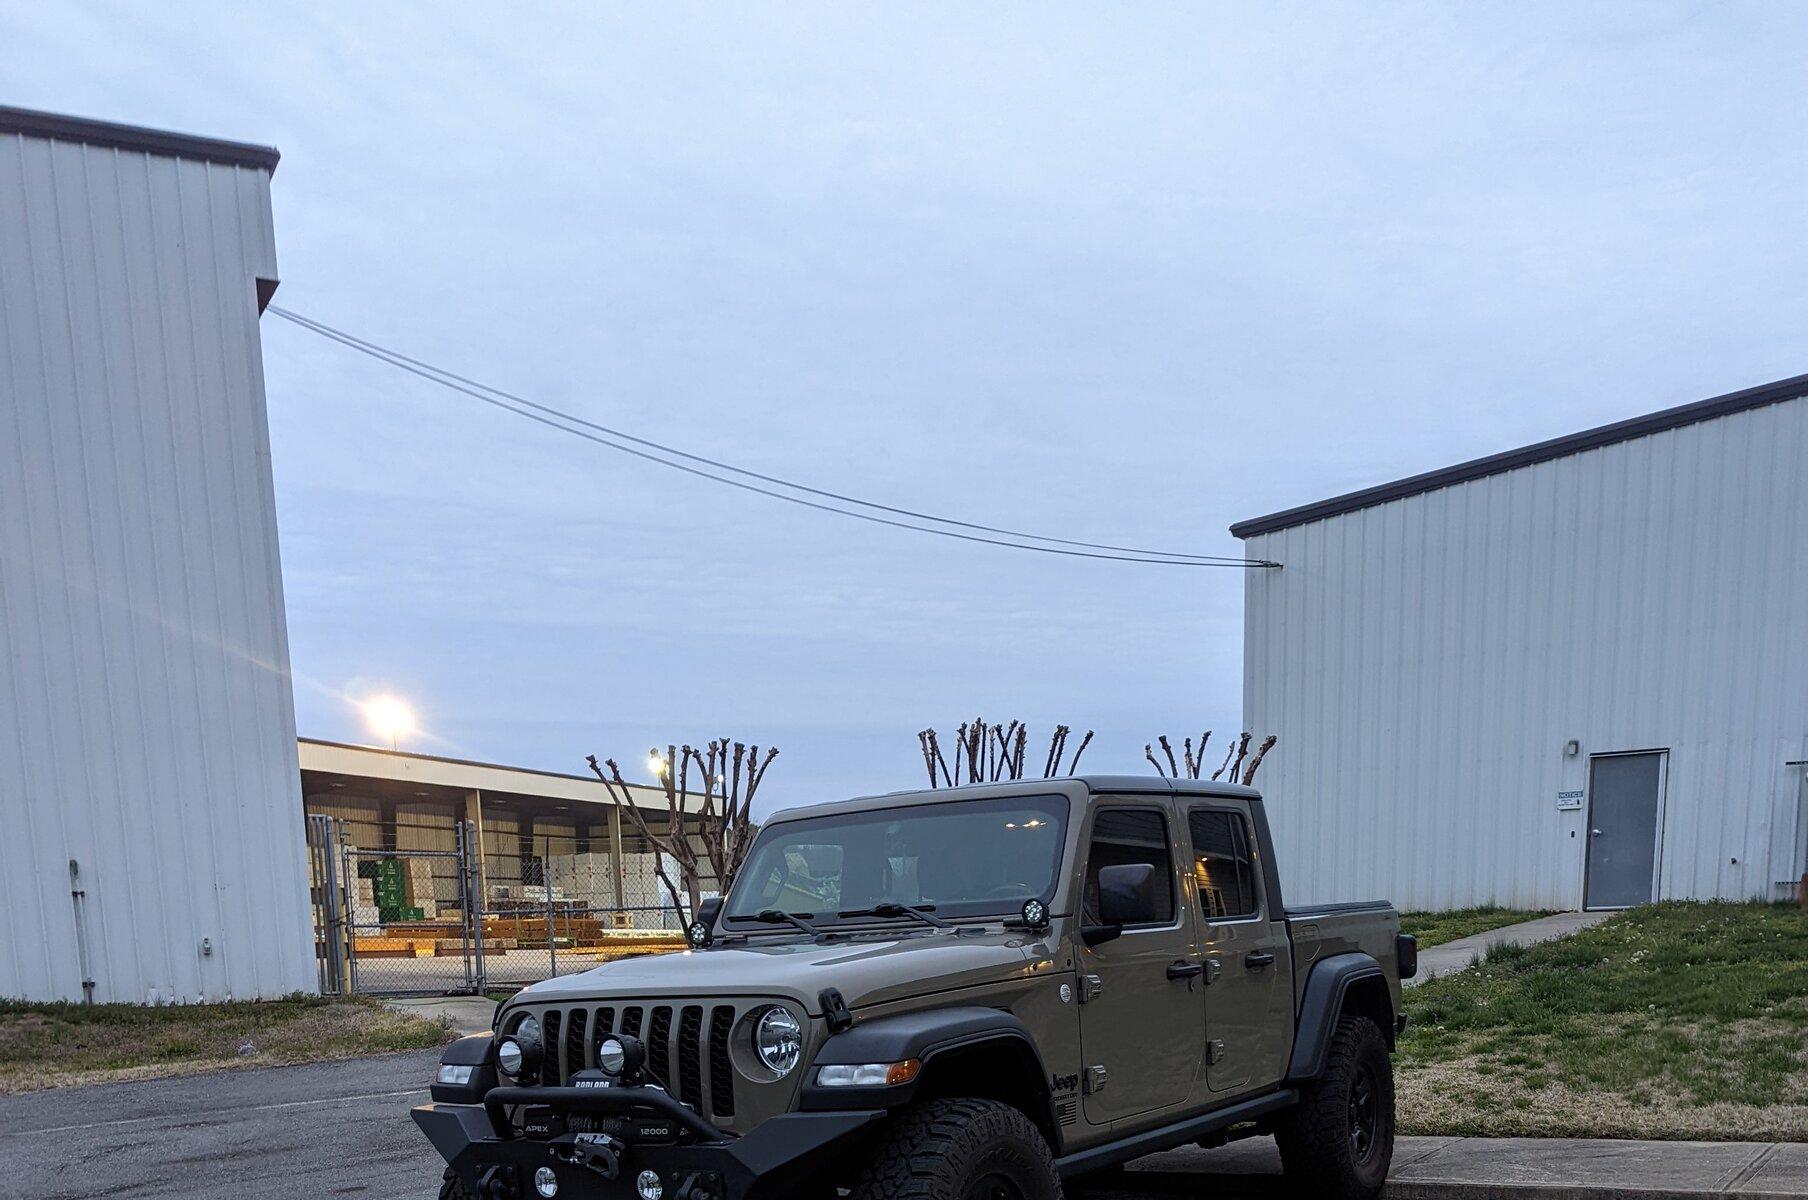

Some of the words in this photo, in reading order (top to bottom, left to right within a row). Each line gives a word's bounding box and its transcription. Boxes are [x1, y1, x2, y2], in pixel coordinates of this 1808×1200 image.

[1050, 1074, 1078, 1092] Jeep
[526, 1125, 549, 1133] APEX
[640, 1127, 669, 1136] 12000
